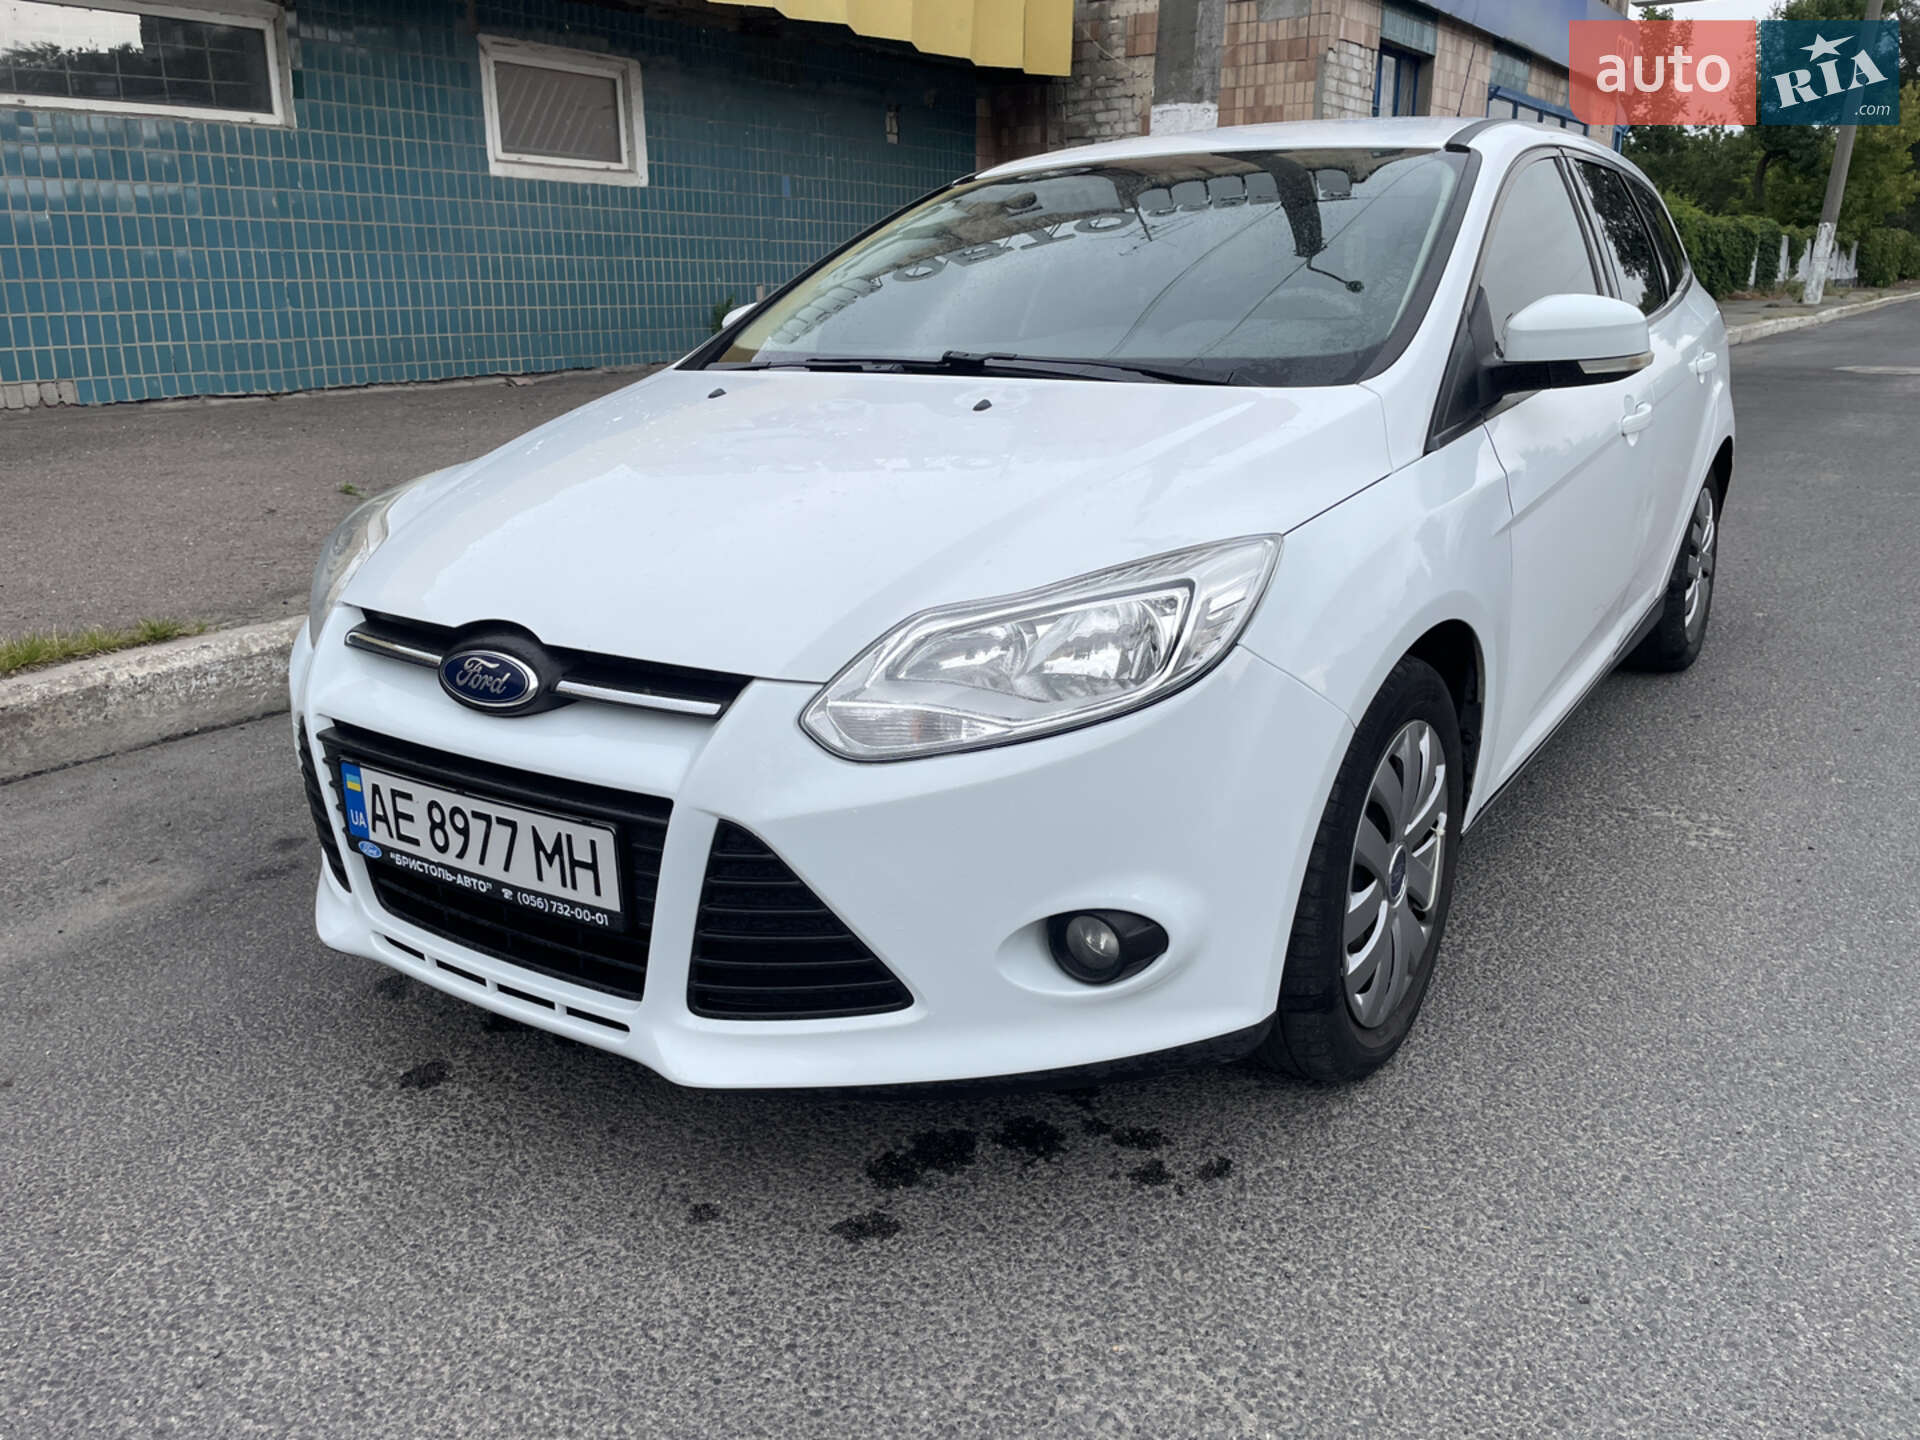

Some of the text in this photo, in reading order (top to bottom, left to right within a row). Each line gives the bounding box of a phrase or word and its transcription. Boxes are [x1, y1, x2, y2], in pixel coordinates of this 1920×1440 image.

[456, 657, 511, 694] Ford
[350, 809, 367, 828] UA
[371, 783, 602, 897] AE 8977 MH
[517, 892, 549, 912] (056)
[550, 901, 608, 926] 732-00-01
